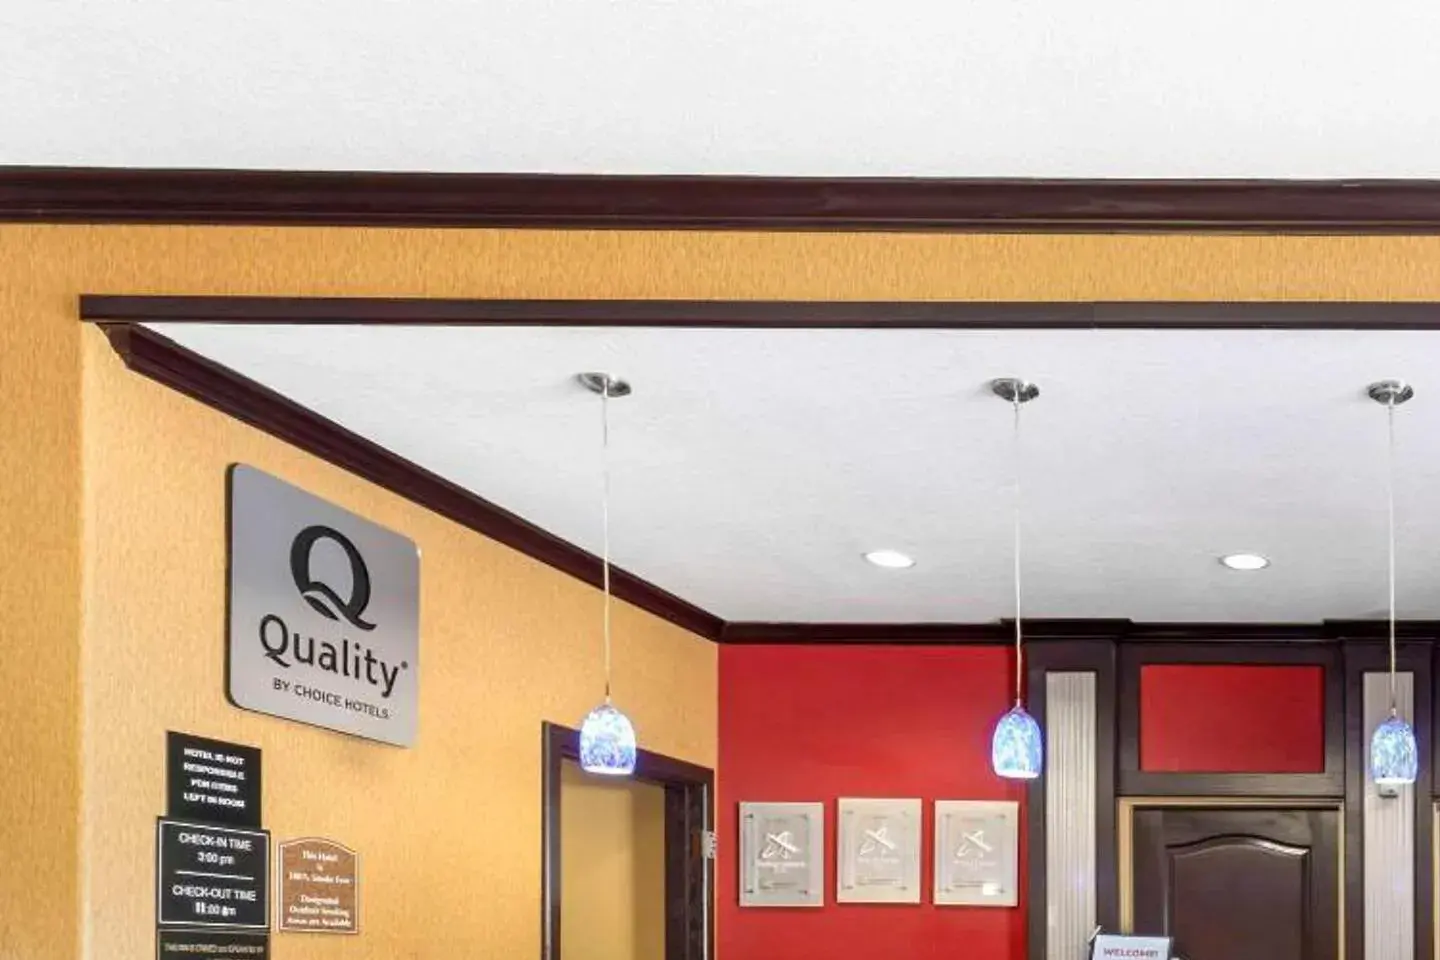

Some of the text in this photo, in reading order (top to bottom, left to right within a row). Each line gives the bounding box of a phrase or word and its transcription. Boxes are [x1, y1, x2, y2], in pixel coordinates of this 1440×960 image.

[259, 614, 399, 698] Quality
[273, 677, 390, 719] BY CHOICE HOTELS
[178, 832, 253, 851] CHECK-IN TIME
[172, 884, 257, 901] CHECK-OUT TIME
